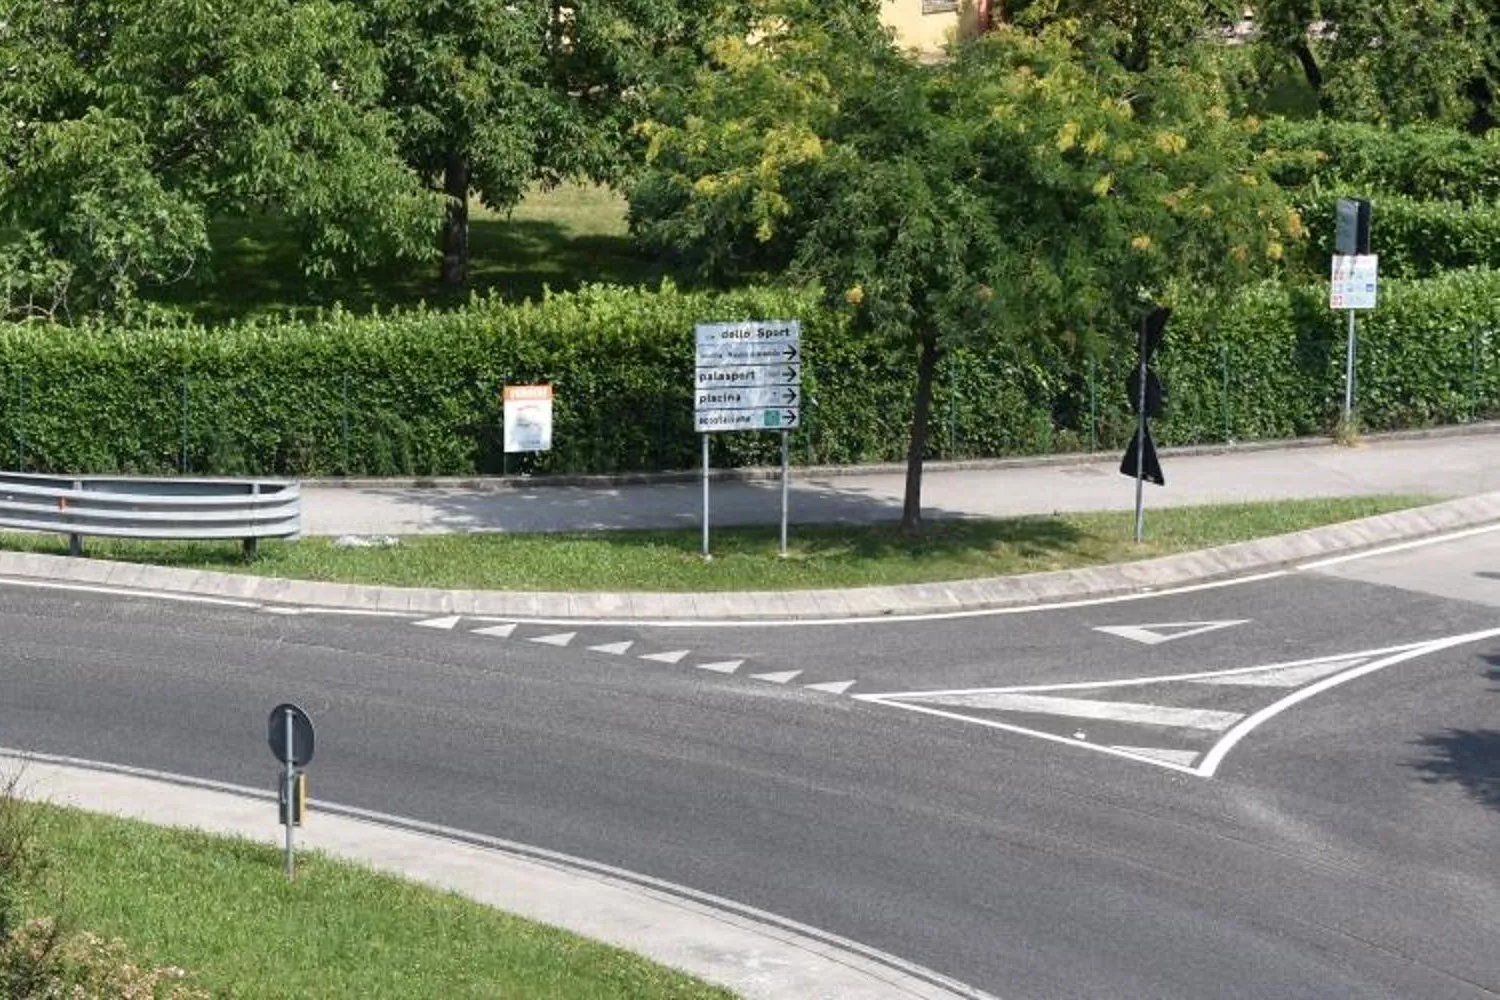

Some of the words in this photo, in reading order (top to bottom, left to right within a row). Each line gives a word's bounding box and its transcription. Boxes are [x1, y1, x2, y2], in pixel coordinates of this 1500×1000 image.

[757, 328, 790, 339] Sport
[699, 371, 756, 383] palasport
[699, 393, 741, 404] piscina
